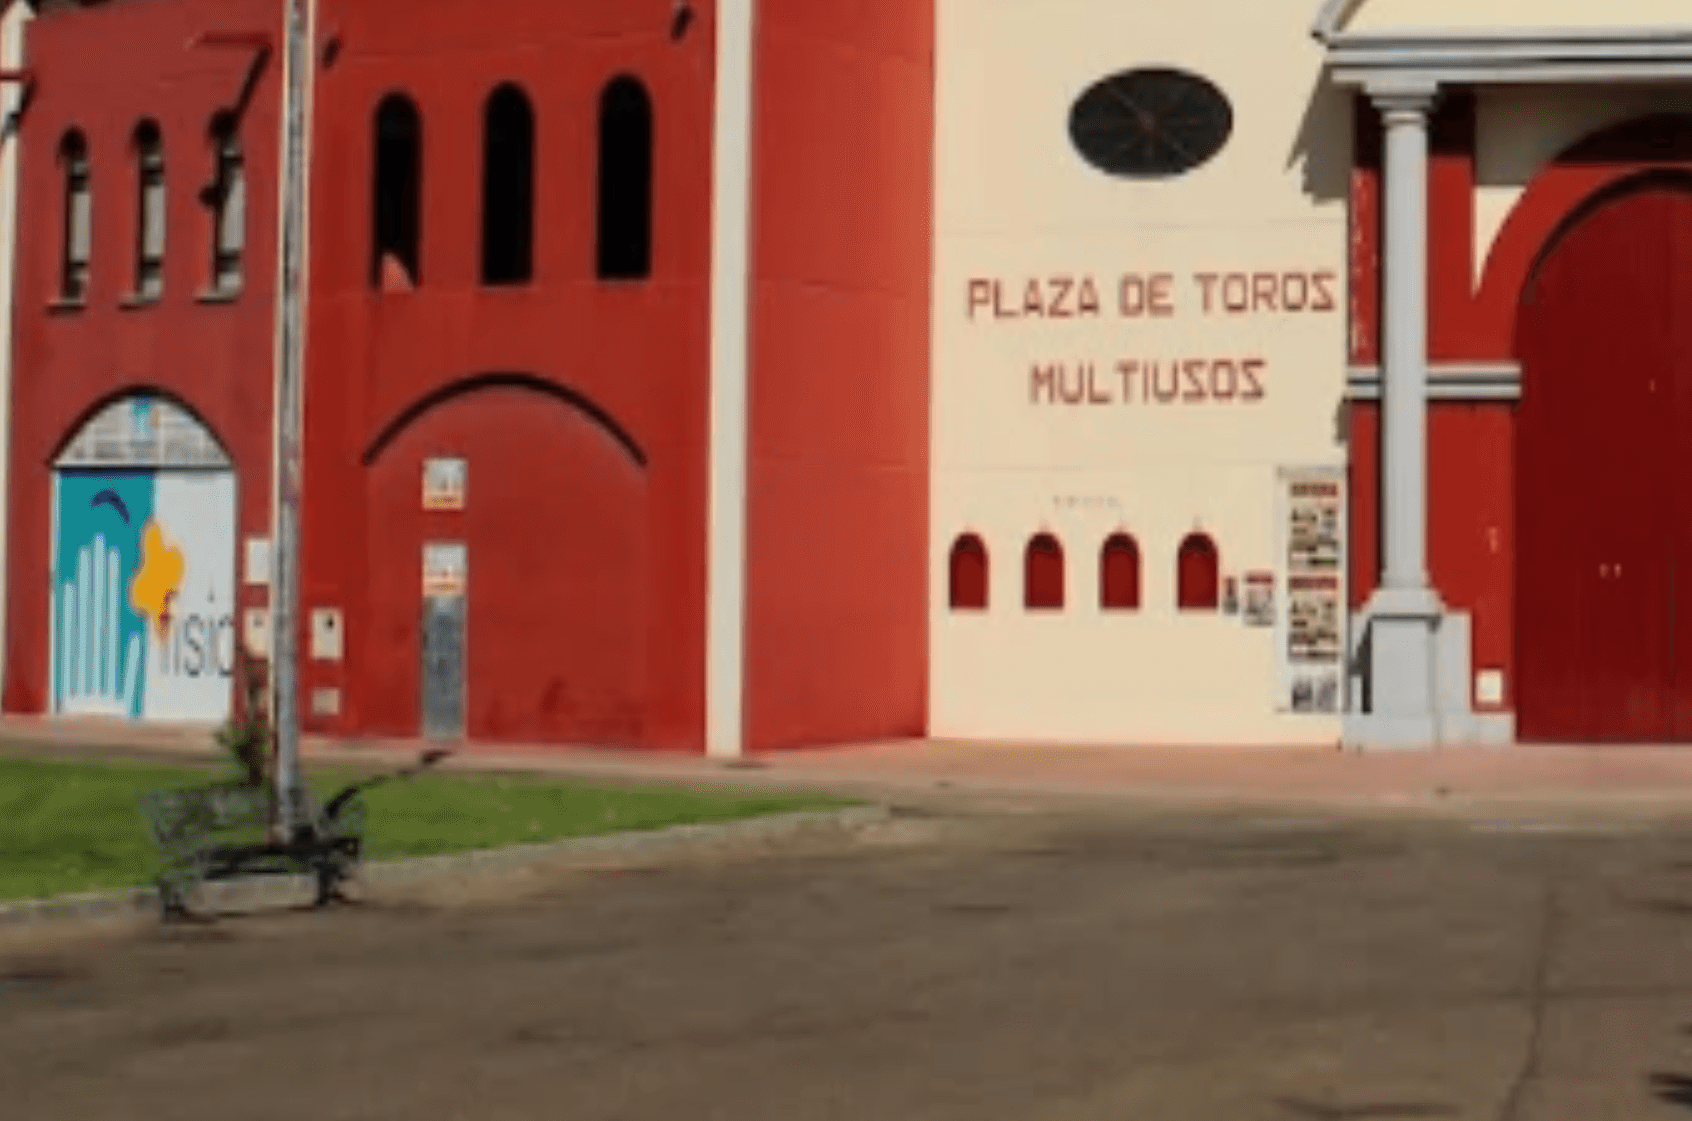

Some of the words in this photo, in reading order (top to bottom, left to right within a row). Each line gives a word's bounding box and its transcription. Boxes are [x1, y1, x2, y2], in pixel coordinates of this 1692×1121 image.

[967, 277, 1101, 319] PLAZA
[1119, 273, 1174, 318] DE
[1194, 272, 1337, 313] TOROS
[1029, 358, 1266, 405] MULTIUSOS
